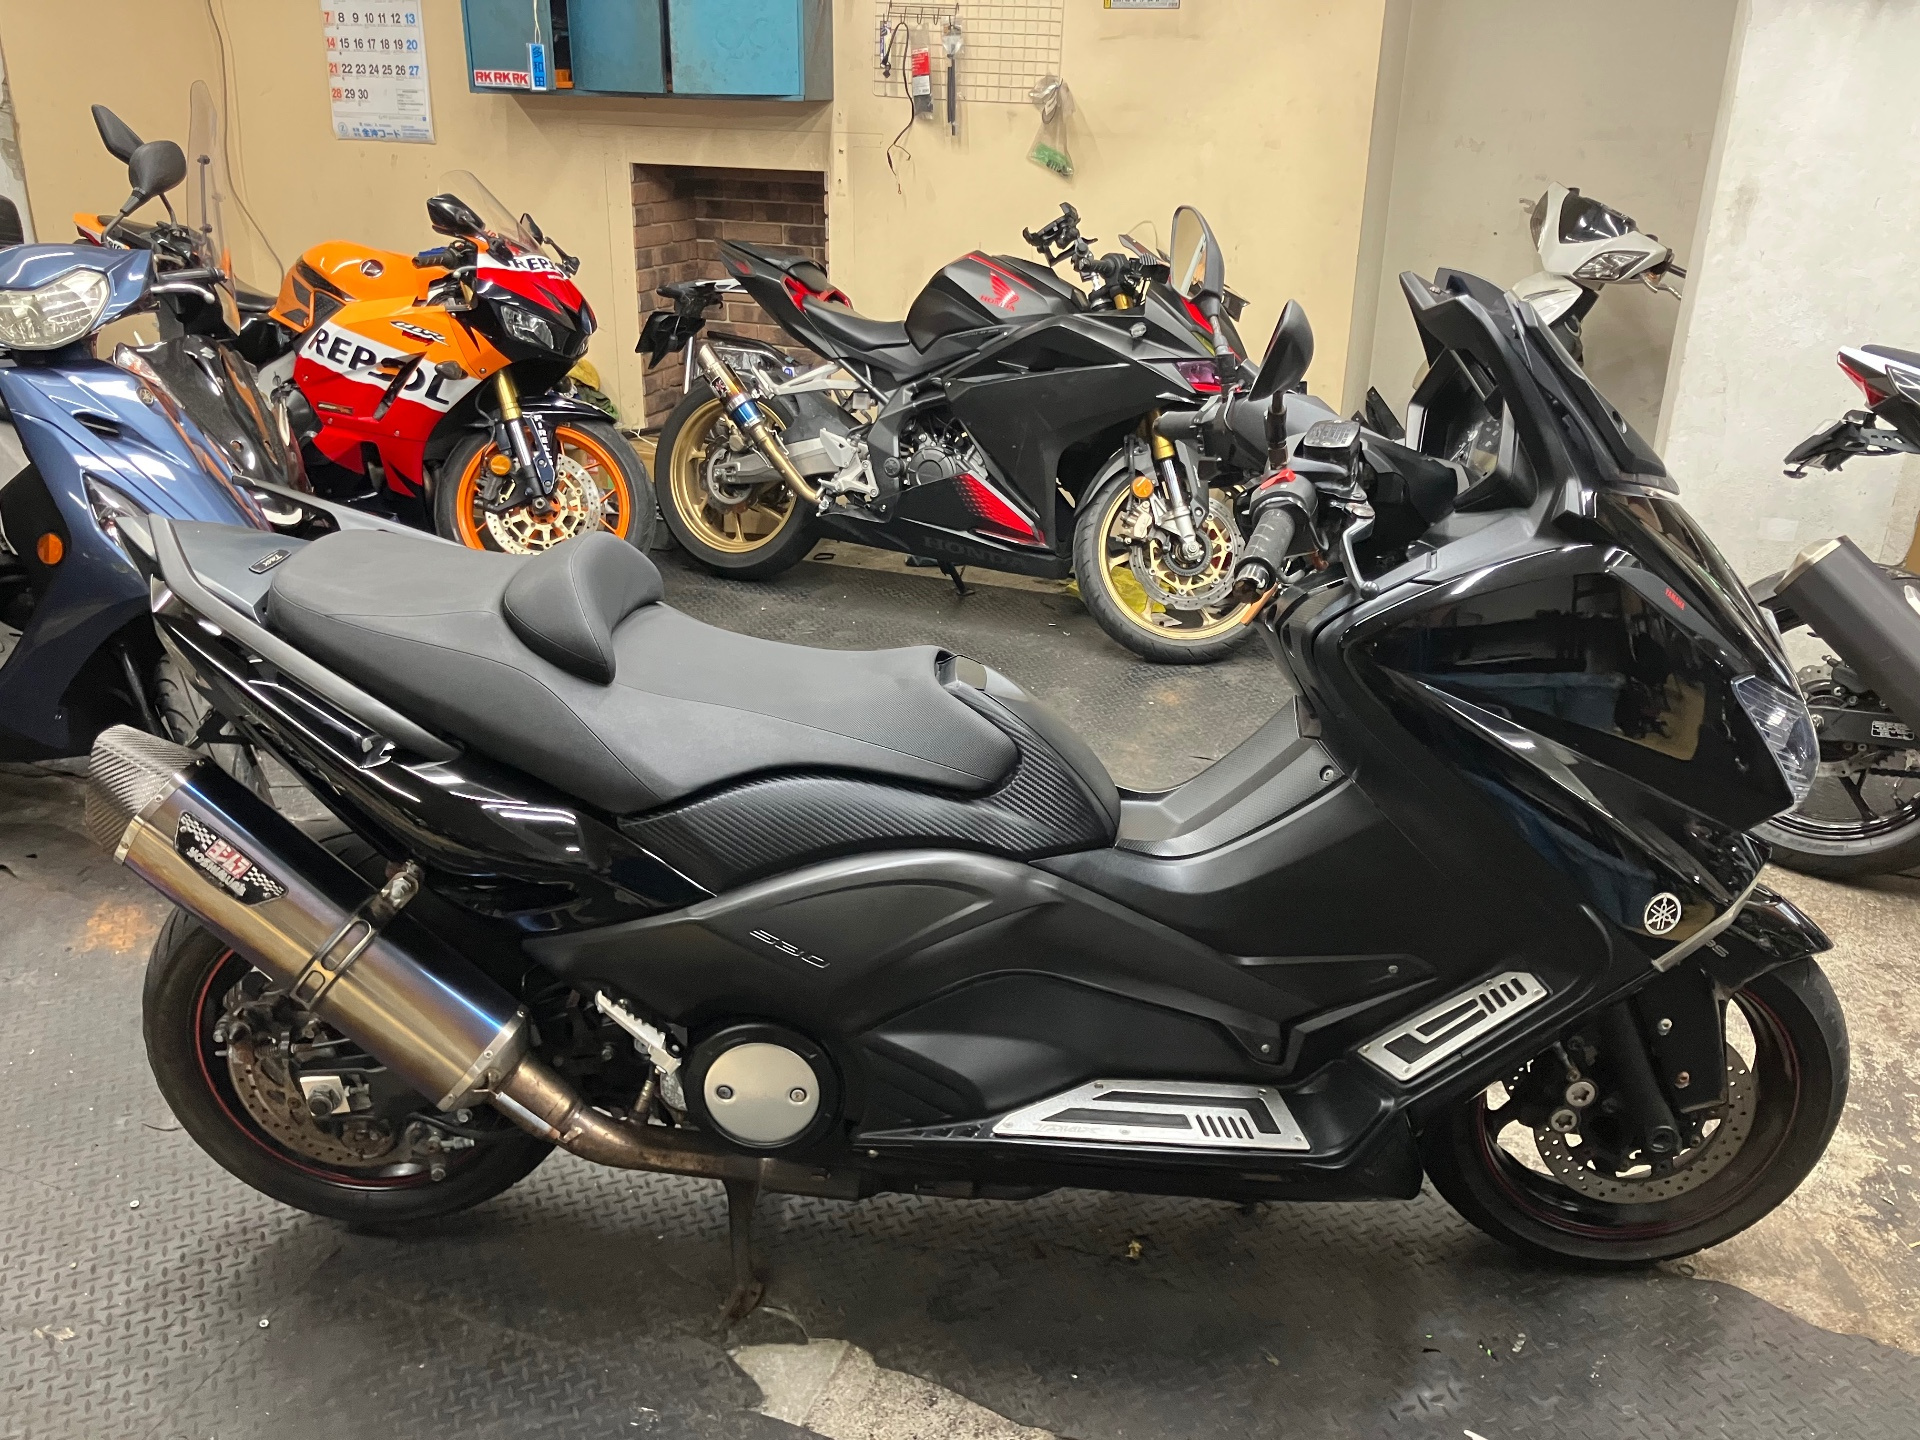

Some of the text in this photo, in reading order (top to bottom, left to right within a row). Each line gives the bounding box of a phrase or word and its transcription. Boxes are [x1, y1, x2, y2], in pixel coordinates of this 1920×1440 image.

[323, 11, 416, 24] 7 8 9 10 11 12 13
[326, 37, 418, 50] 14 15 16 17 18 19 20
[328, 62, 420, 76] 21 22 23 24 25 26 27
[475, 71, 493, 83] RK
[493, 71, 512, 83] RK
[511, 72, 529, 85] RK
[331, 88, 369, 100] 28 29 30
[749, 929, 831, 969] 530
[1705, 939, 1730, 958] BS
